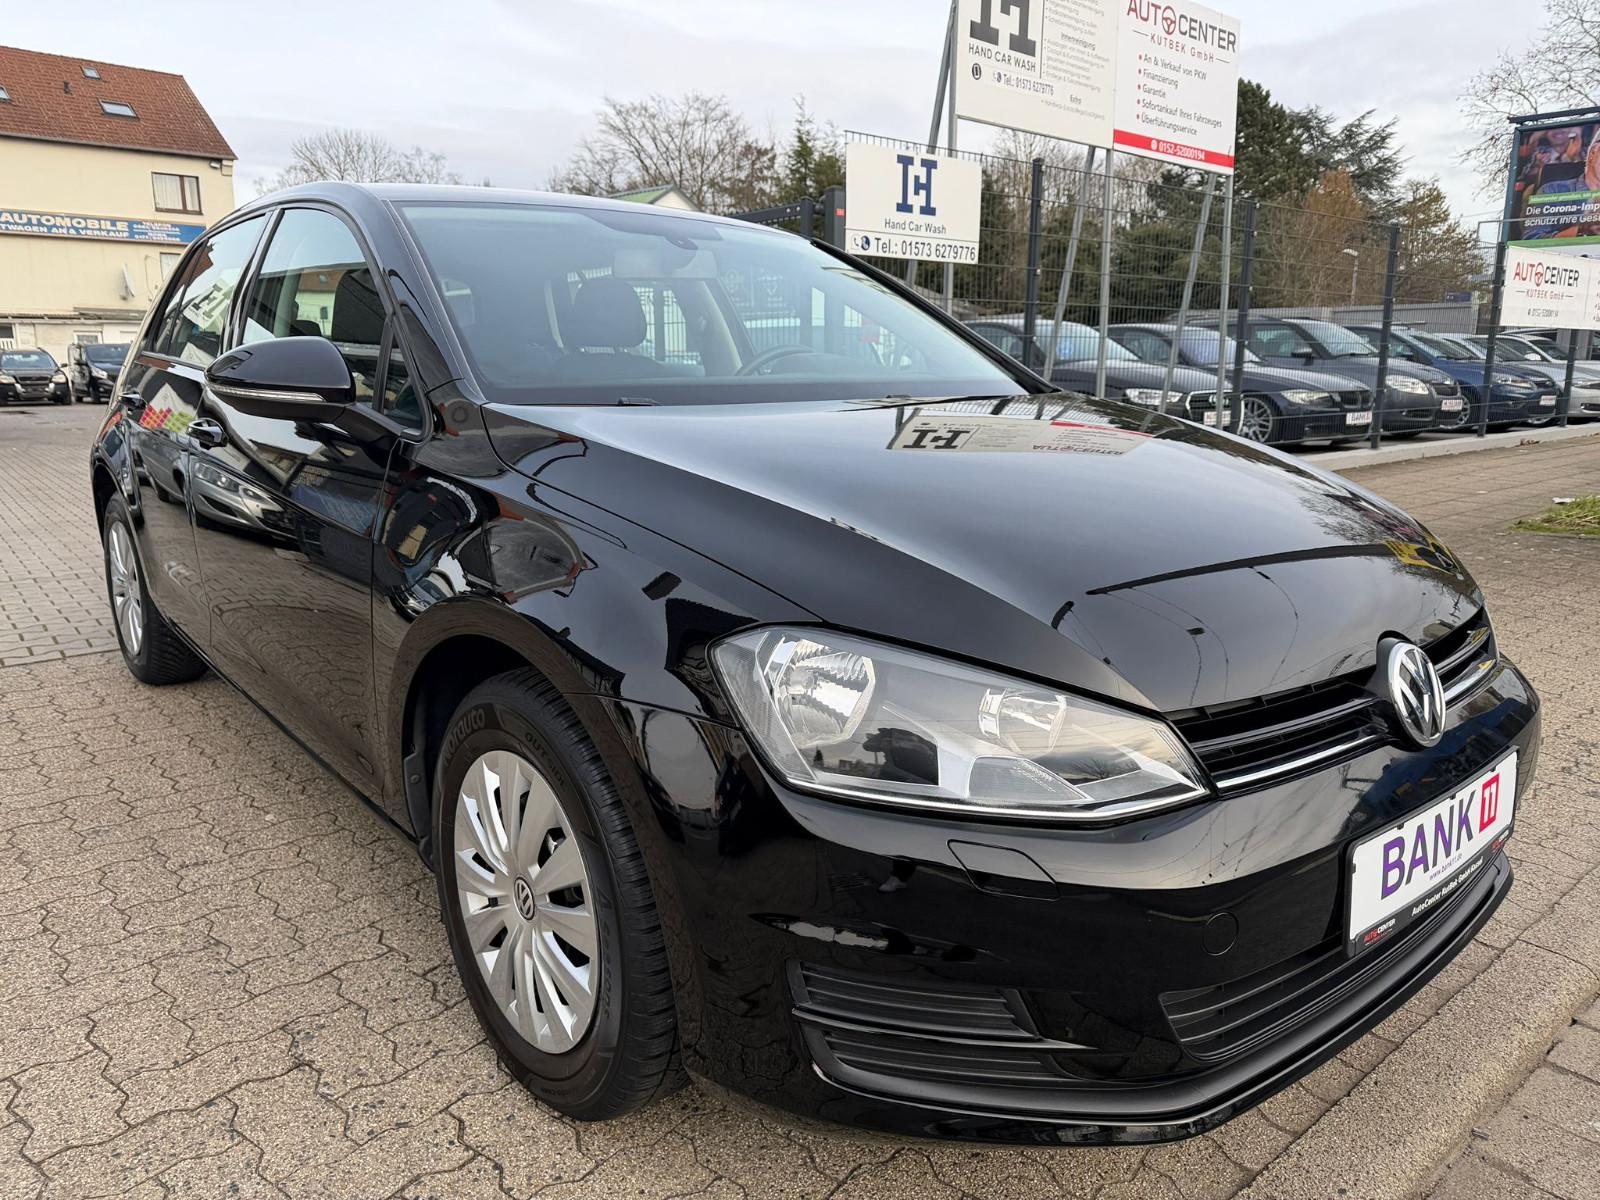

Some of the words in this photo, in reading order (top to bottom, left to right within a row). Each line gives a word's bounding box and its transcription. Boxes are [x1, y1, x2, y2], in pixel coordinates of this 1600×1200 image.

[968, 43, 992, 59] HAND
[994, 51, 1012, 65] CAR
[1014, 56, 1036, 72] WASH
[1150, 33, 1186, 54] KUTBEK
[1190, 47, 1214, 63] GmbH
[1143, 54, 1152, 63] An
[1153, 57, 1159, 66] &
[1160, 58, 1181, 72] Verkauf
[1182, 67, 1193, 76] von
[1194, 69, 1207, 80] PKW
[1143, 69, 1178, 89] Finanzierung
[1142, 84, 1166, 98] Garantie
[1141, 112, 1197, 136] Überführungsservice
[1142, 98, 1178, 115] Sofortankauf
[1179, 109, 1192, 120] Ihres
[1193, 113, 1222, 128] Fahrzeuges
[0, 212, 129, 231] AUTOMOBILE
[1526, 206, 1541, 216] Die
[79, 229, 129, 238] VERKAUF
[884, 218, 906, 230] Hand
[908, 221, 923, 232] Car
[925, 222, 947, 234] Wash
[874, 237, 898, 255] Tel.:
[901, 240, 932, 257] 01573
[935, 243, 976, 261] 6279776
[1381, 790, 1476, 900] BANK
[1411, 891, 1442, 917] AutoCenter
